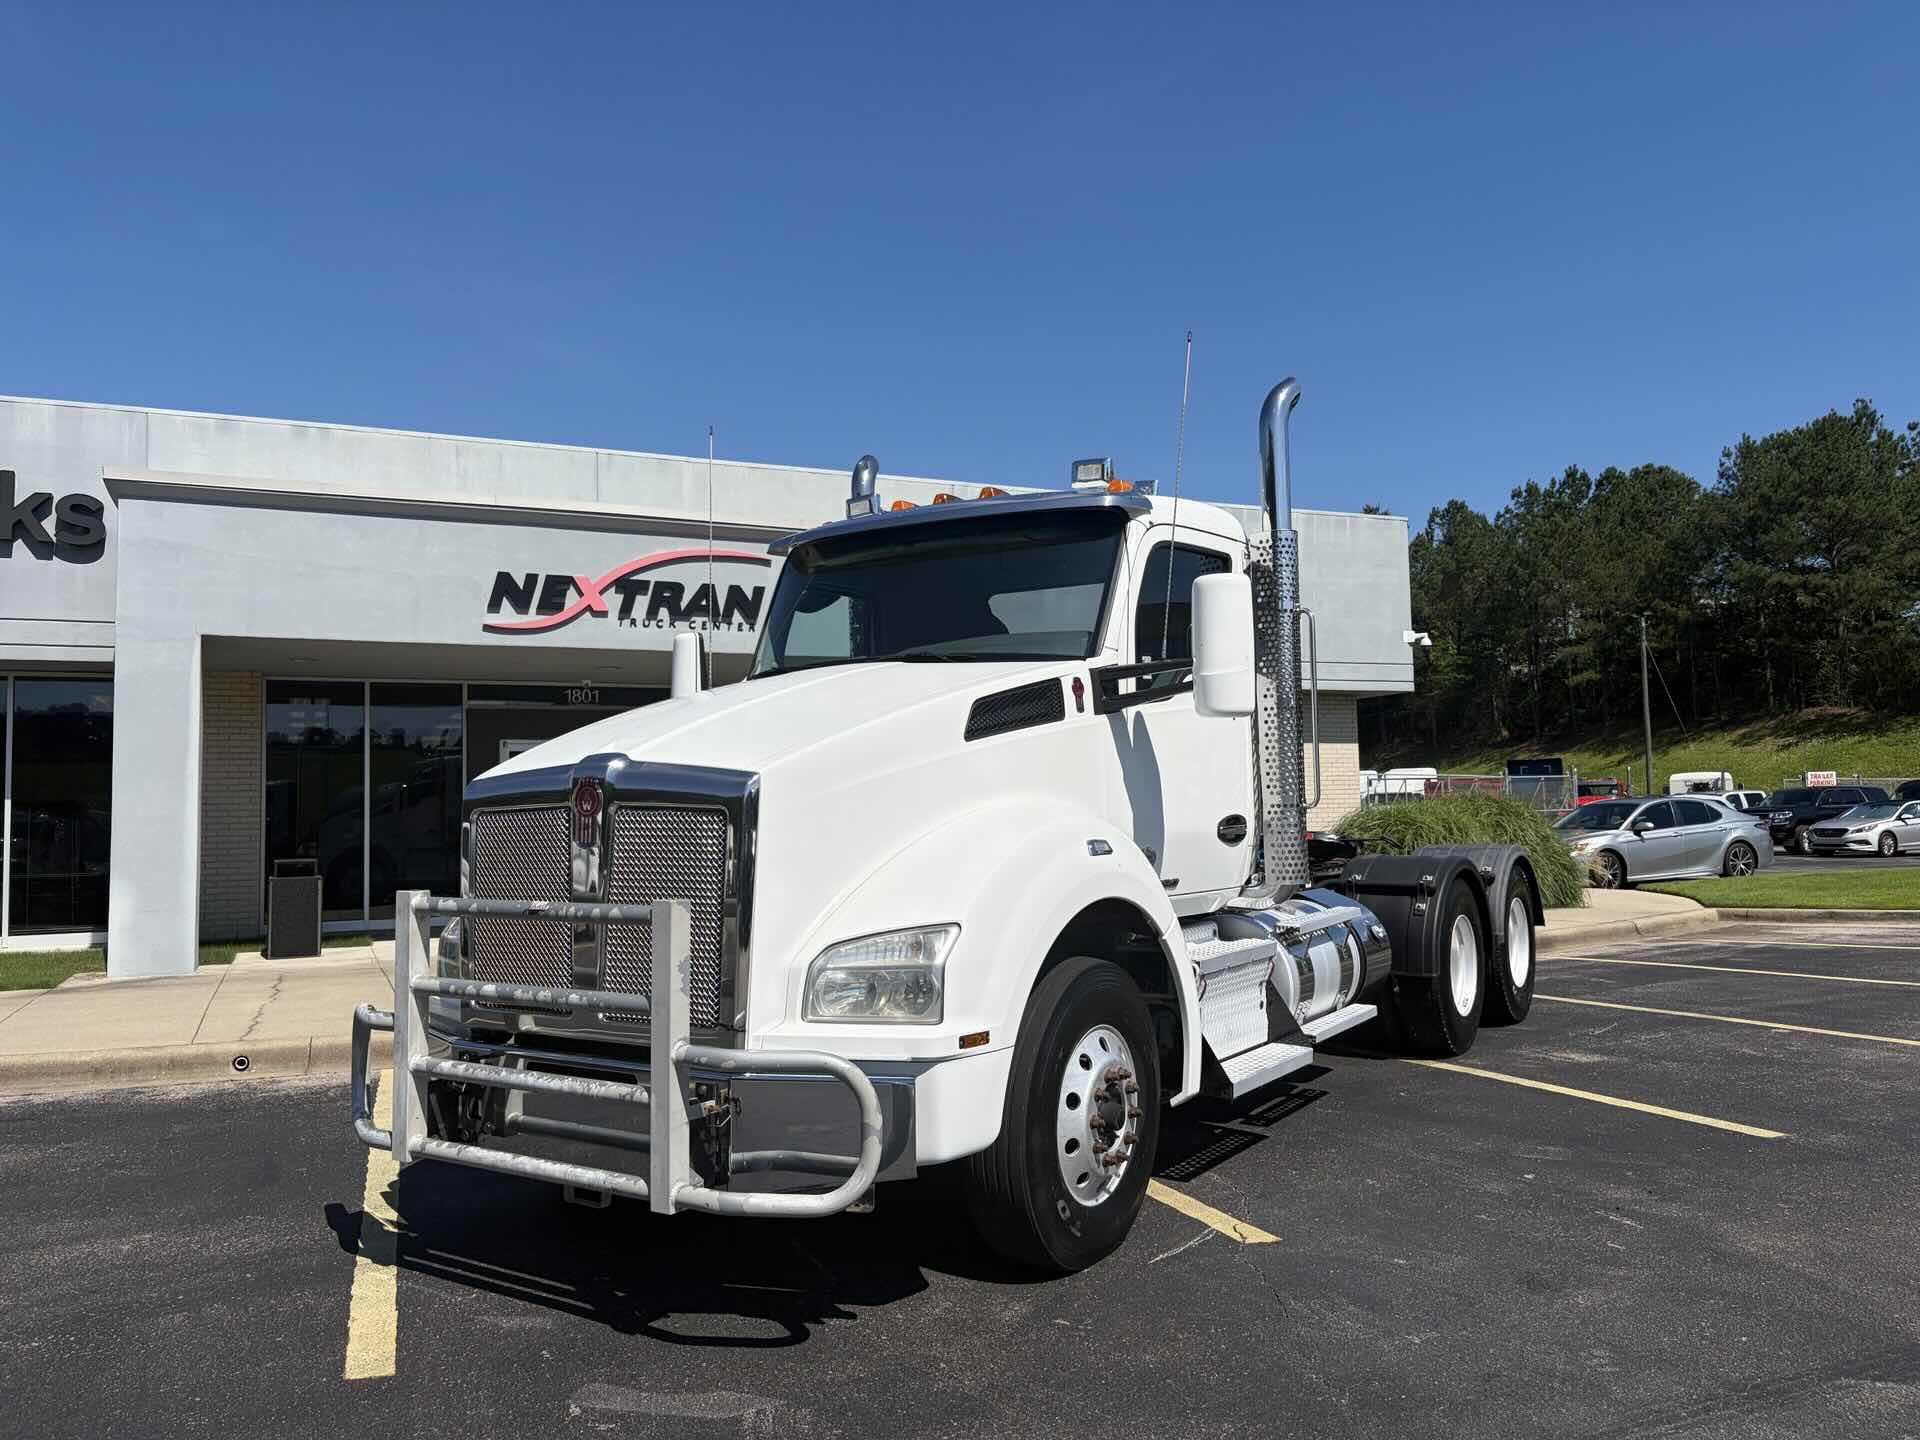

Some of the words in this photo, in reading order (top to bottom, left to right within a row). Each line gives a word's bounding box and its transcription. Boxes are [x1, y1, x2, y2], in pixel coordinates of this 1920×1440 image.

[487, 571, 765, 625] NEXTRAN
[618, 618, 677, 629] TRUCK
[689, 620, 756, 632] CENTER
[563, 688, 600, 704] 1801
